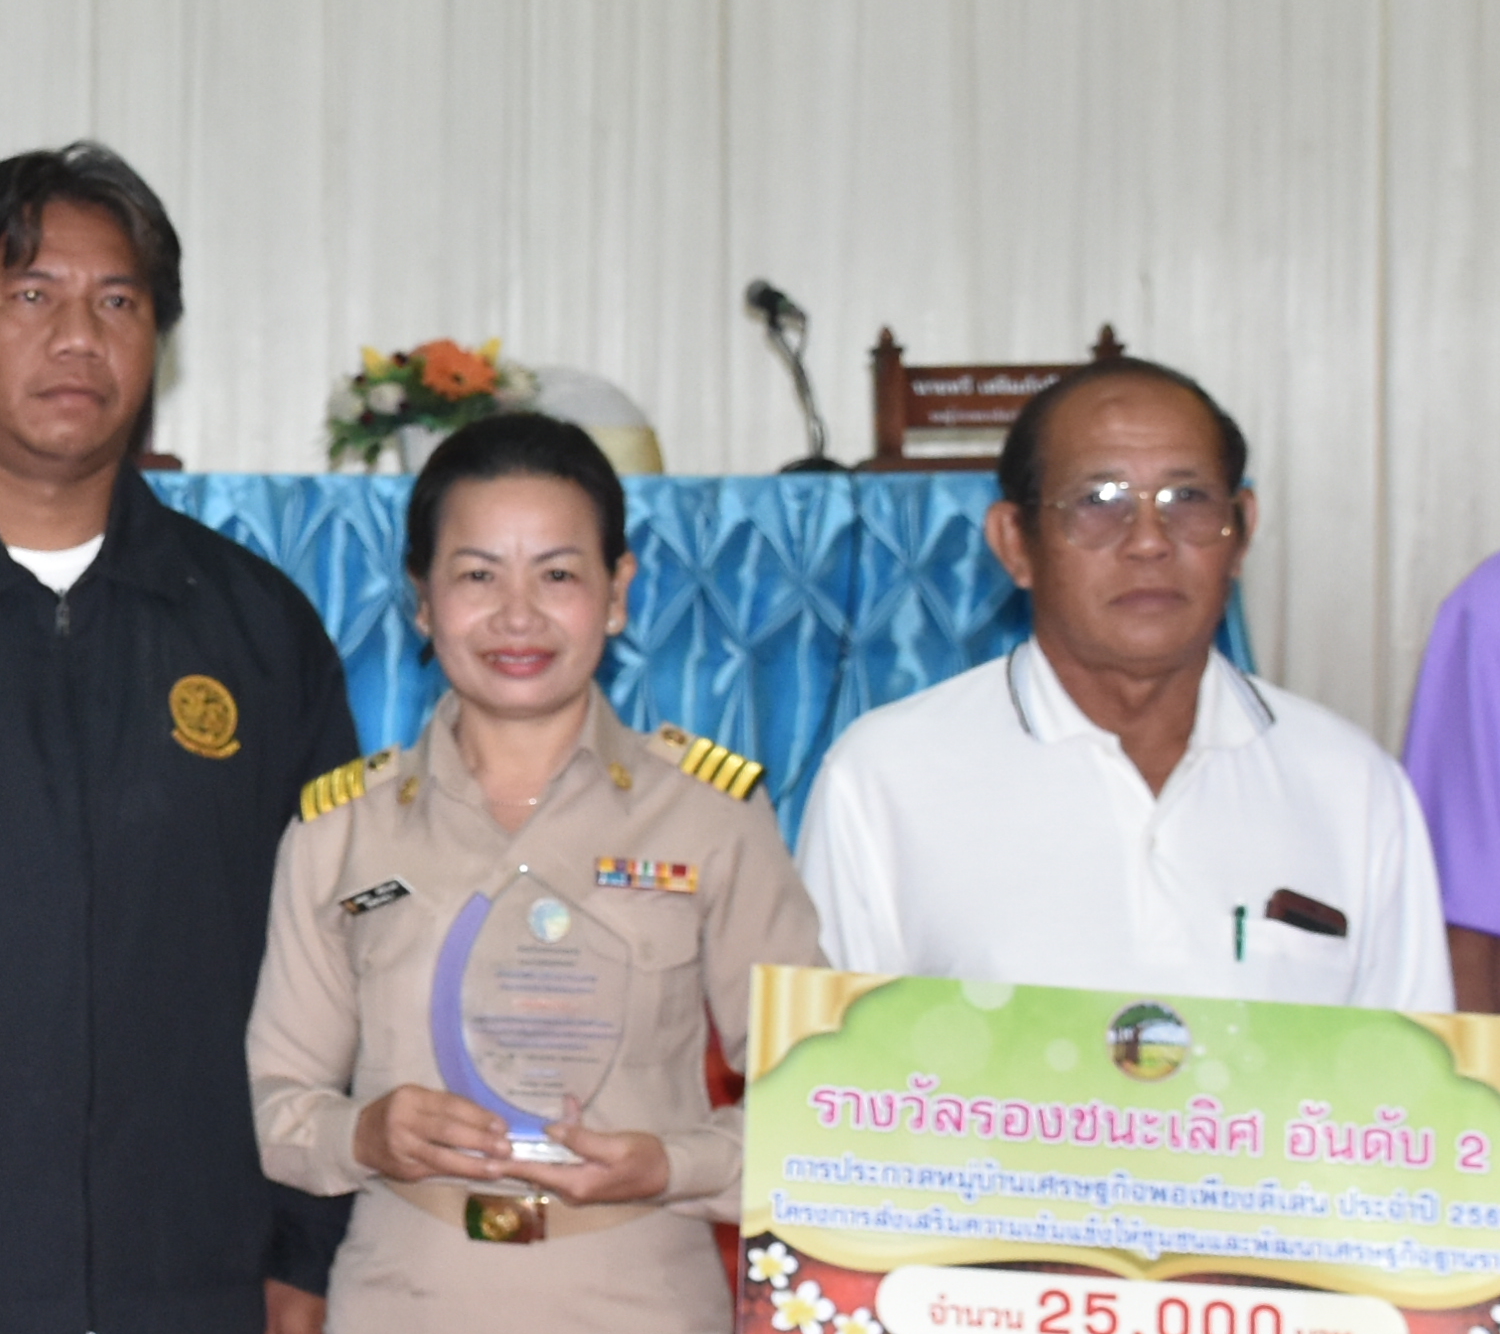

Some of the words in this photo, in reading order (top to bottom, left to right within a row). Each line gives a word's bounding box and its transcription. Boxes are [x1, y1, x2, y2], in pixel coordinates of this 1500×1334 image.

[812, 1076, 1260, 1154] รางวัลรองชนะเลิศ
[1288, 1103, 1434, 1165] อันดับ
[1457, 1135, 1487, 1171] 2
[929, 1294, 1025, 1331] จำนวน
